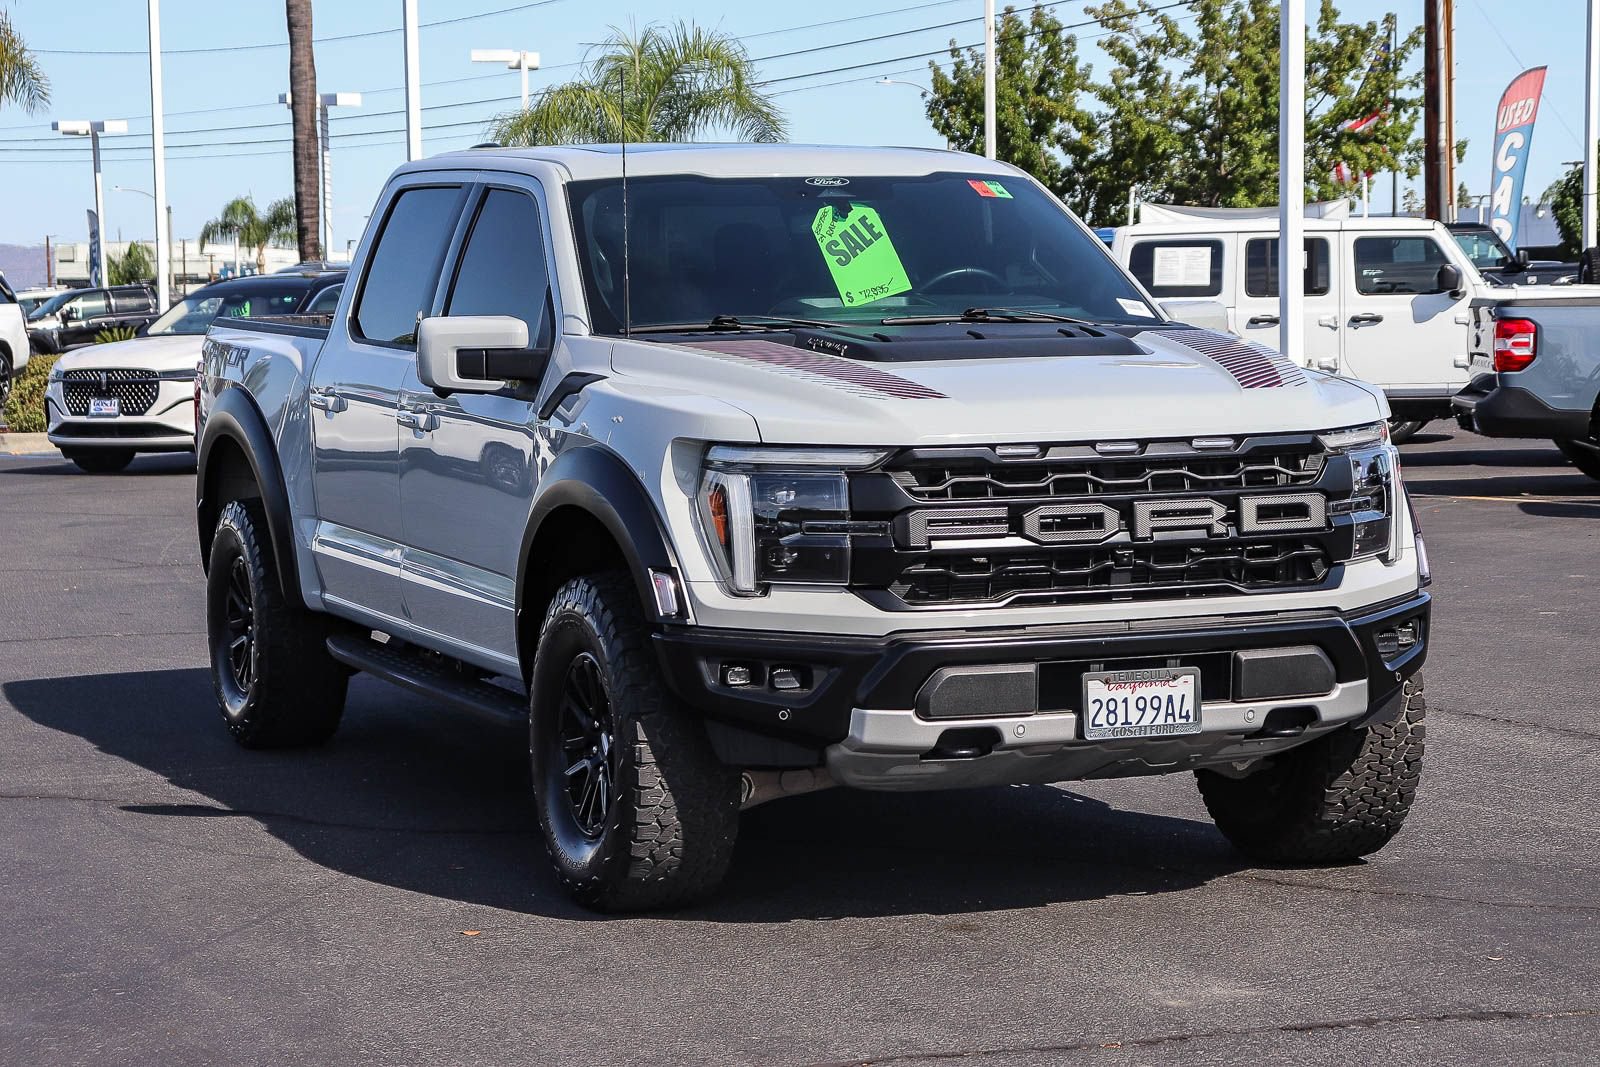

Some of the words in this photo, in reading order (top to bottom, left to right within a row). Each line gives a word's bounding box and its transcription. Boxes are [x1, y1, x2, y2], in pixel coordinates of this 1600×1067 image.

[1499, 98, 1535, 130] USED
[813, 177, 842, 185] Ford
[826, 214, 884, 267] SALE
[845, 290, 855, 303] $
[907, 492, 1328, 549] FORD
[1111, 670, 1172, 682] TEMECULA
[1091, 693, 1191, 728] 28199A4
[1112, 726, 1147, 738] GOSCH
[1150, 723, 1175, 735] FORD
